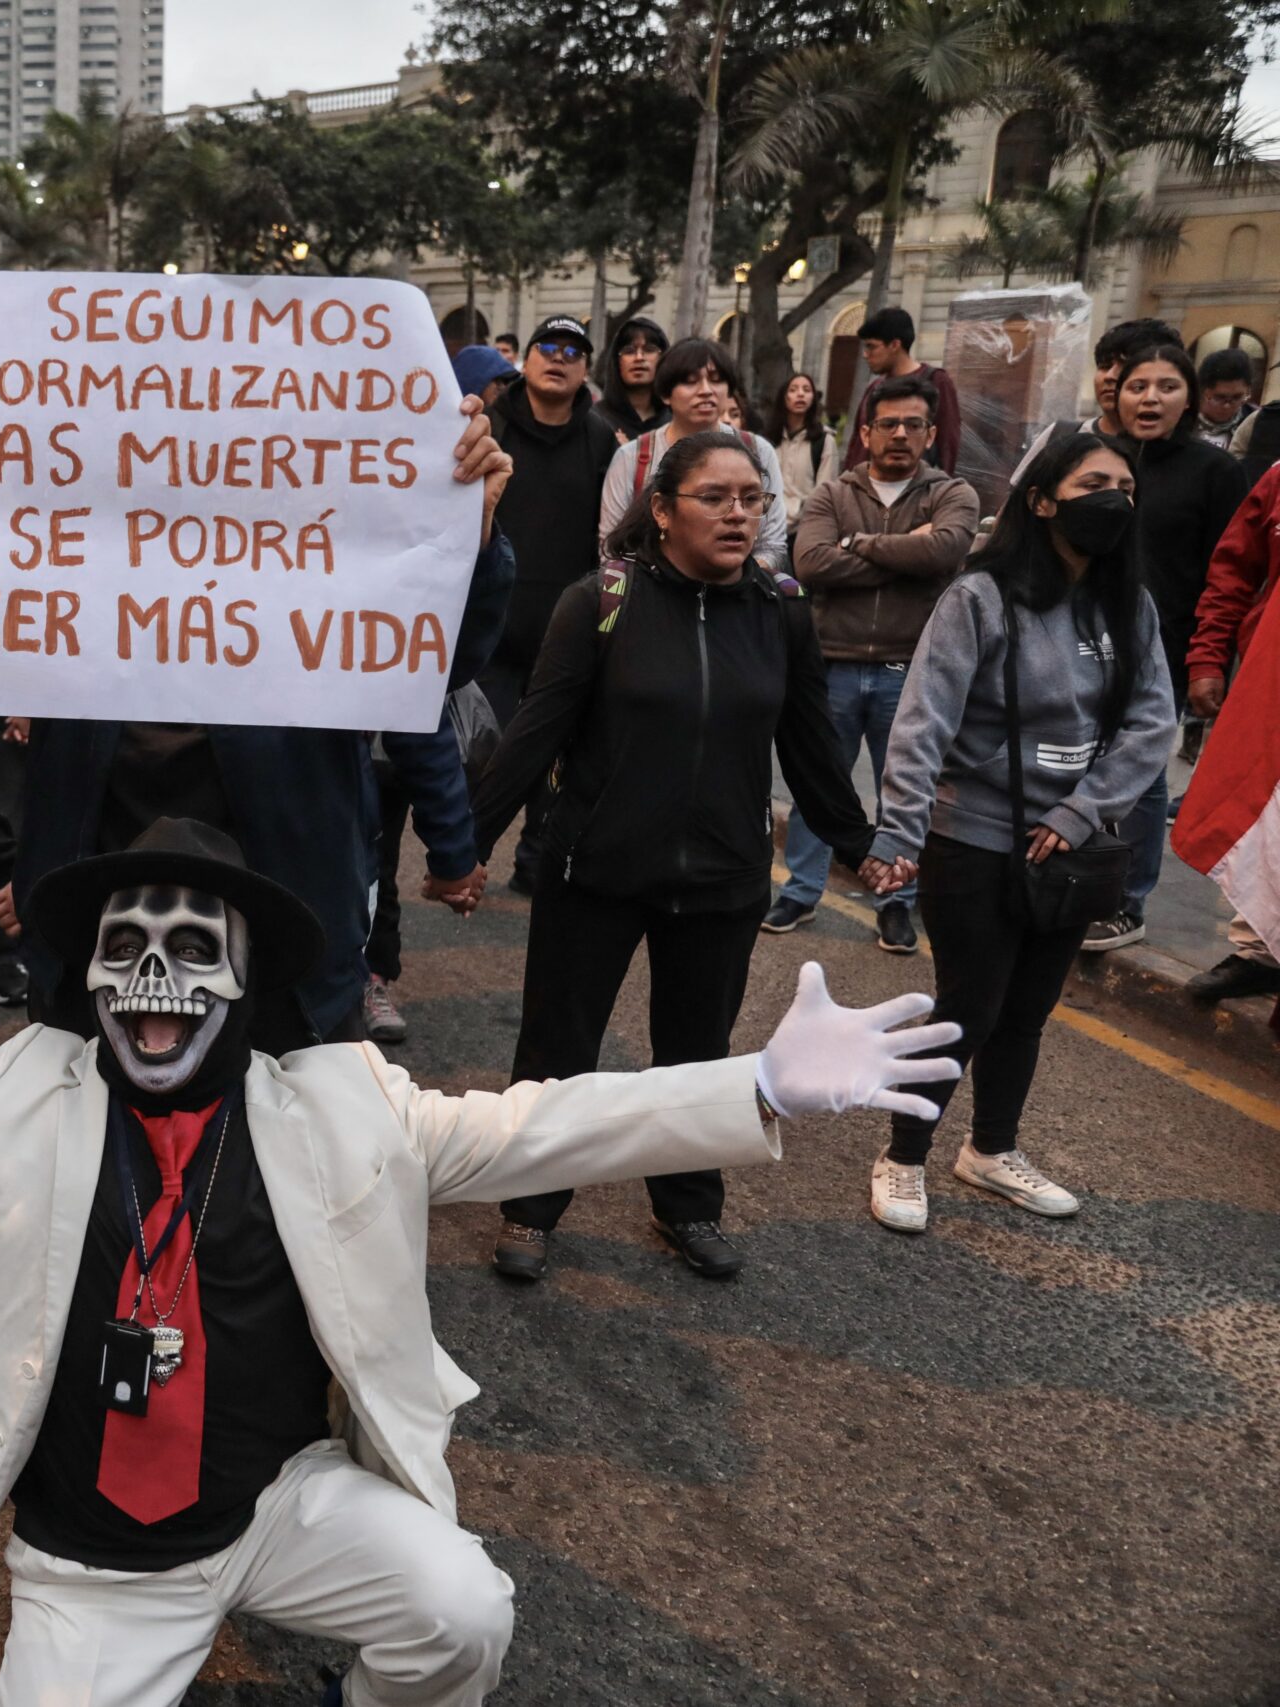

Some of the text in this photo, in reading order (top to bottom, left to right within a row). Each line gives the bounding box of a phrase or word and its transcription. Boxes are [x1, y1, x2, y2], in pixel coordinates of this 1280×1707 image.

[47, 286, 393, 350] SEGUIMOS
[117, 431, 418, 490] MUERTES
[9, 506, 92, 571] SE
[126, 507, 337, 575] PODRÁ
[117, 579, 260, 668] MÁS
[289, 608, 448, 674] VIDA
